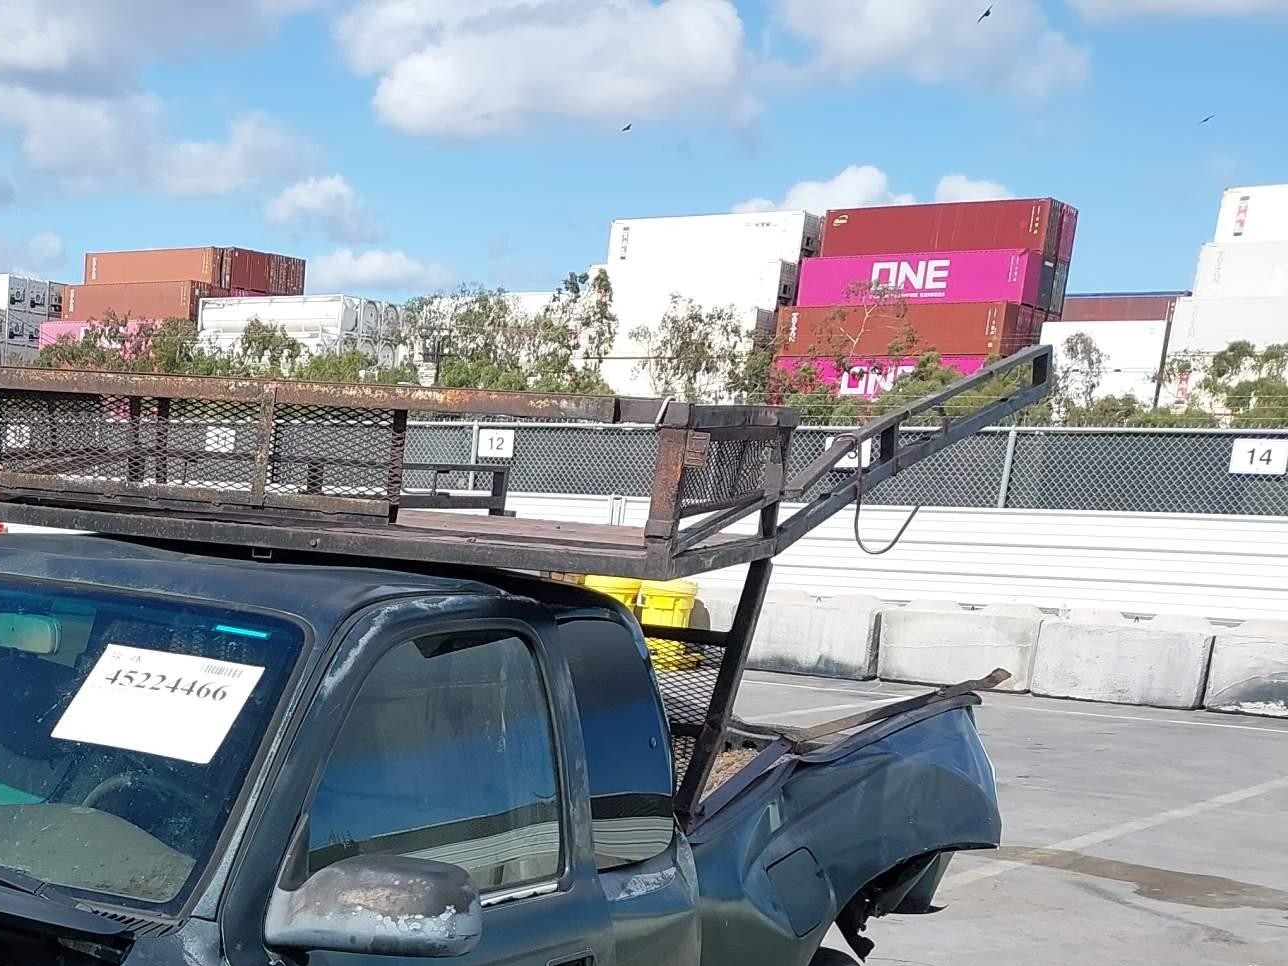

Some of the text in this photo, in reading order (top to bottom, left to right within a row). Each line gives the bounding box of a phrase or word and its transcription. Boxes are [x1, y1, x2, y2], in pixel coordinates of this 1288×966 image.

[870, 259, 951, 291] ONE
[840, 366, 915, 395] ON
[488, 436, 505, 450] 12
[1247, 447, 1273, 465] 14
[104, 668, 232, 701] 45224466
